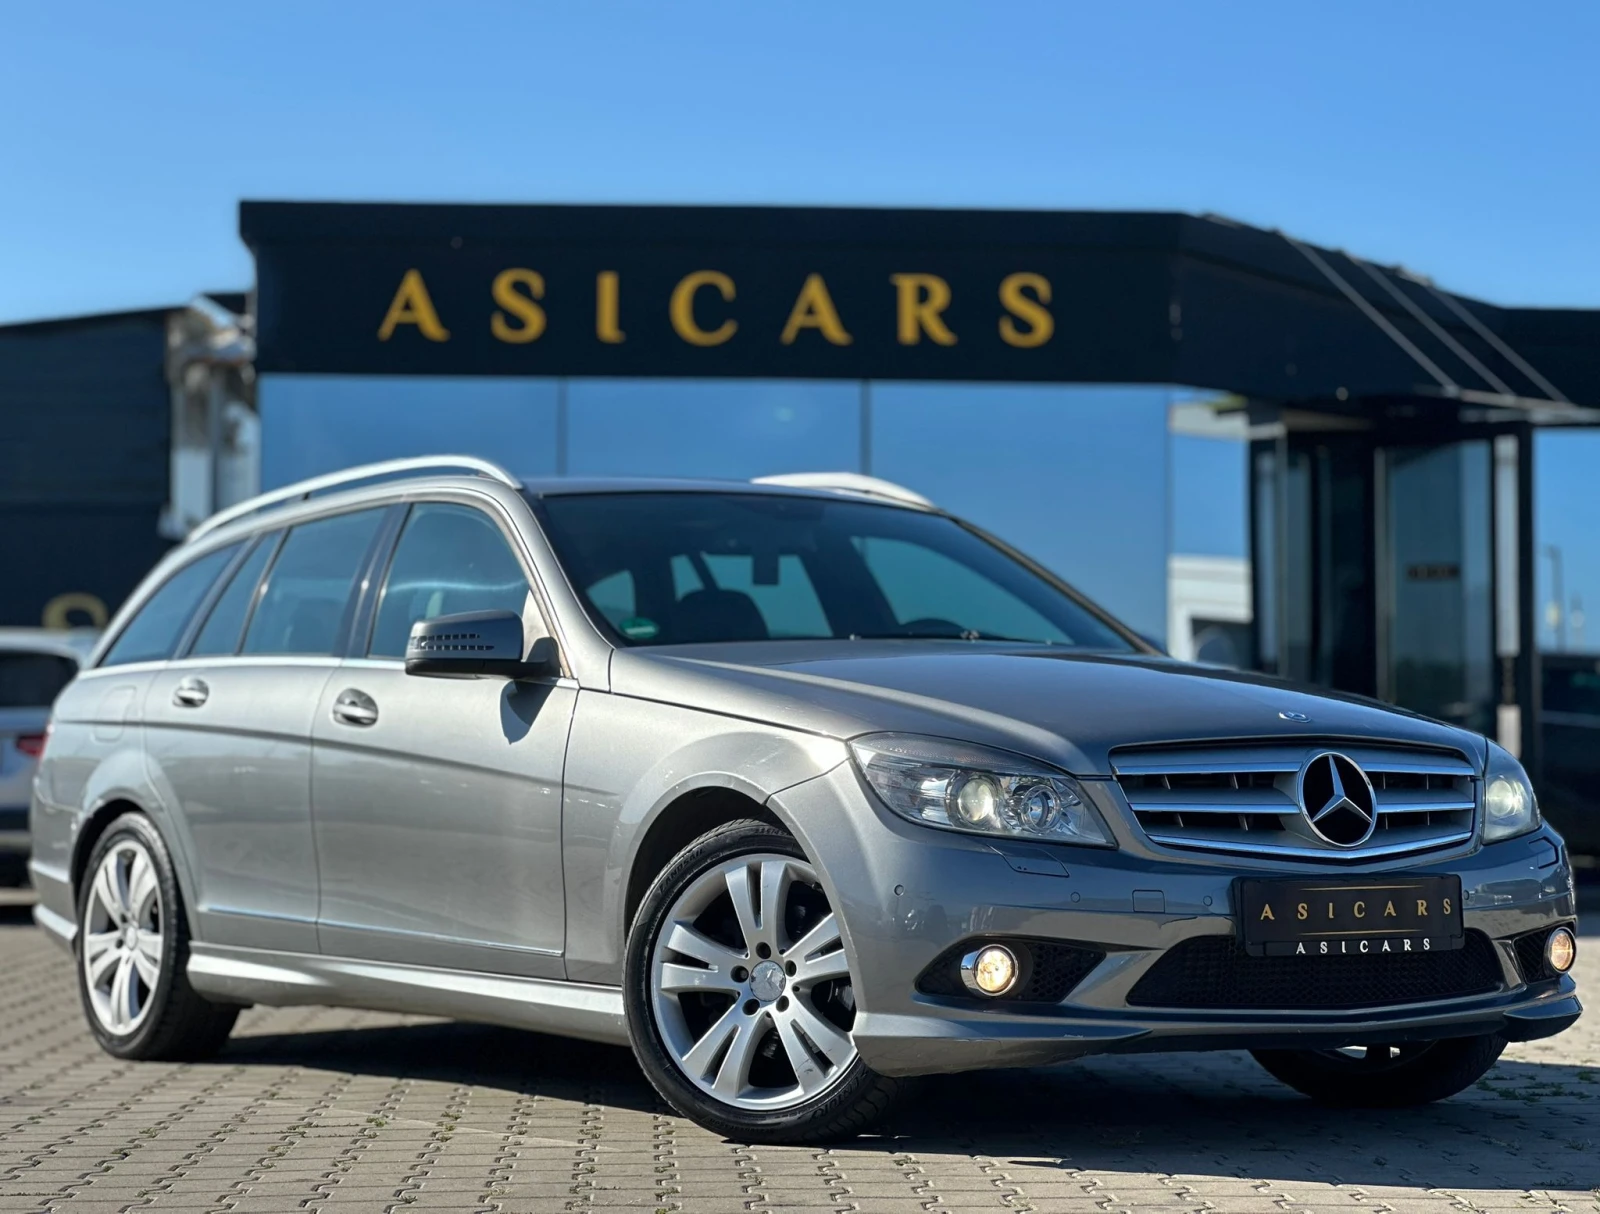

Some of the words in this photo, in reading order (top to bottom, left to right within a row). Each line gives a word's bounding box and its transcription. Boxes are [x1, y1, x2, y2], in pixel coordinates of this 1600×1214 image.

[377, 267, 1055, 349] ASICARS
[1260, 898, 1452, 921] ASICARS
[1296, 938, 1431, 955] ASICARS
